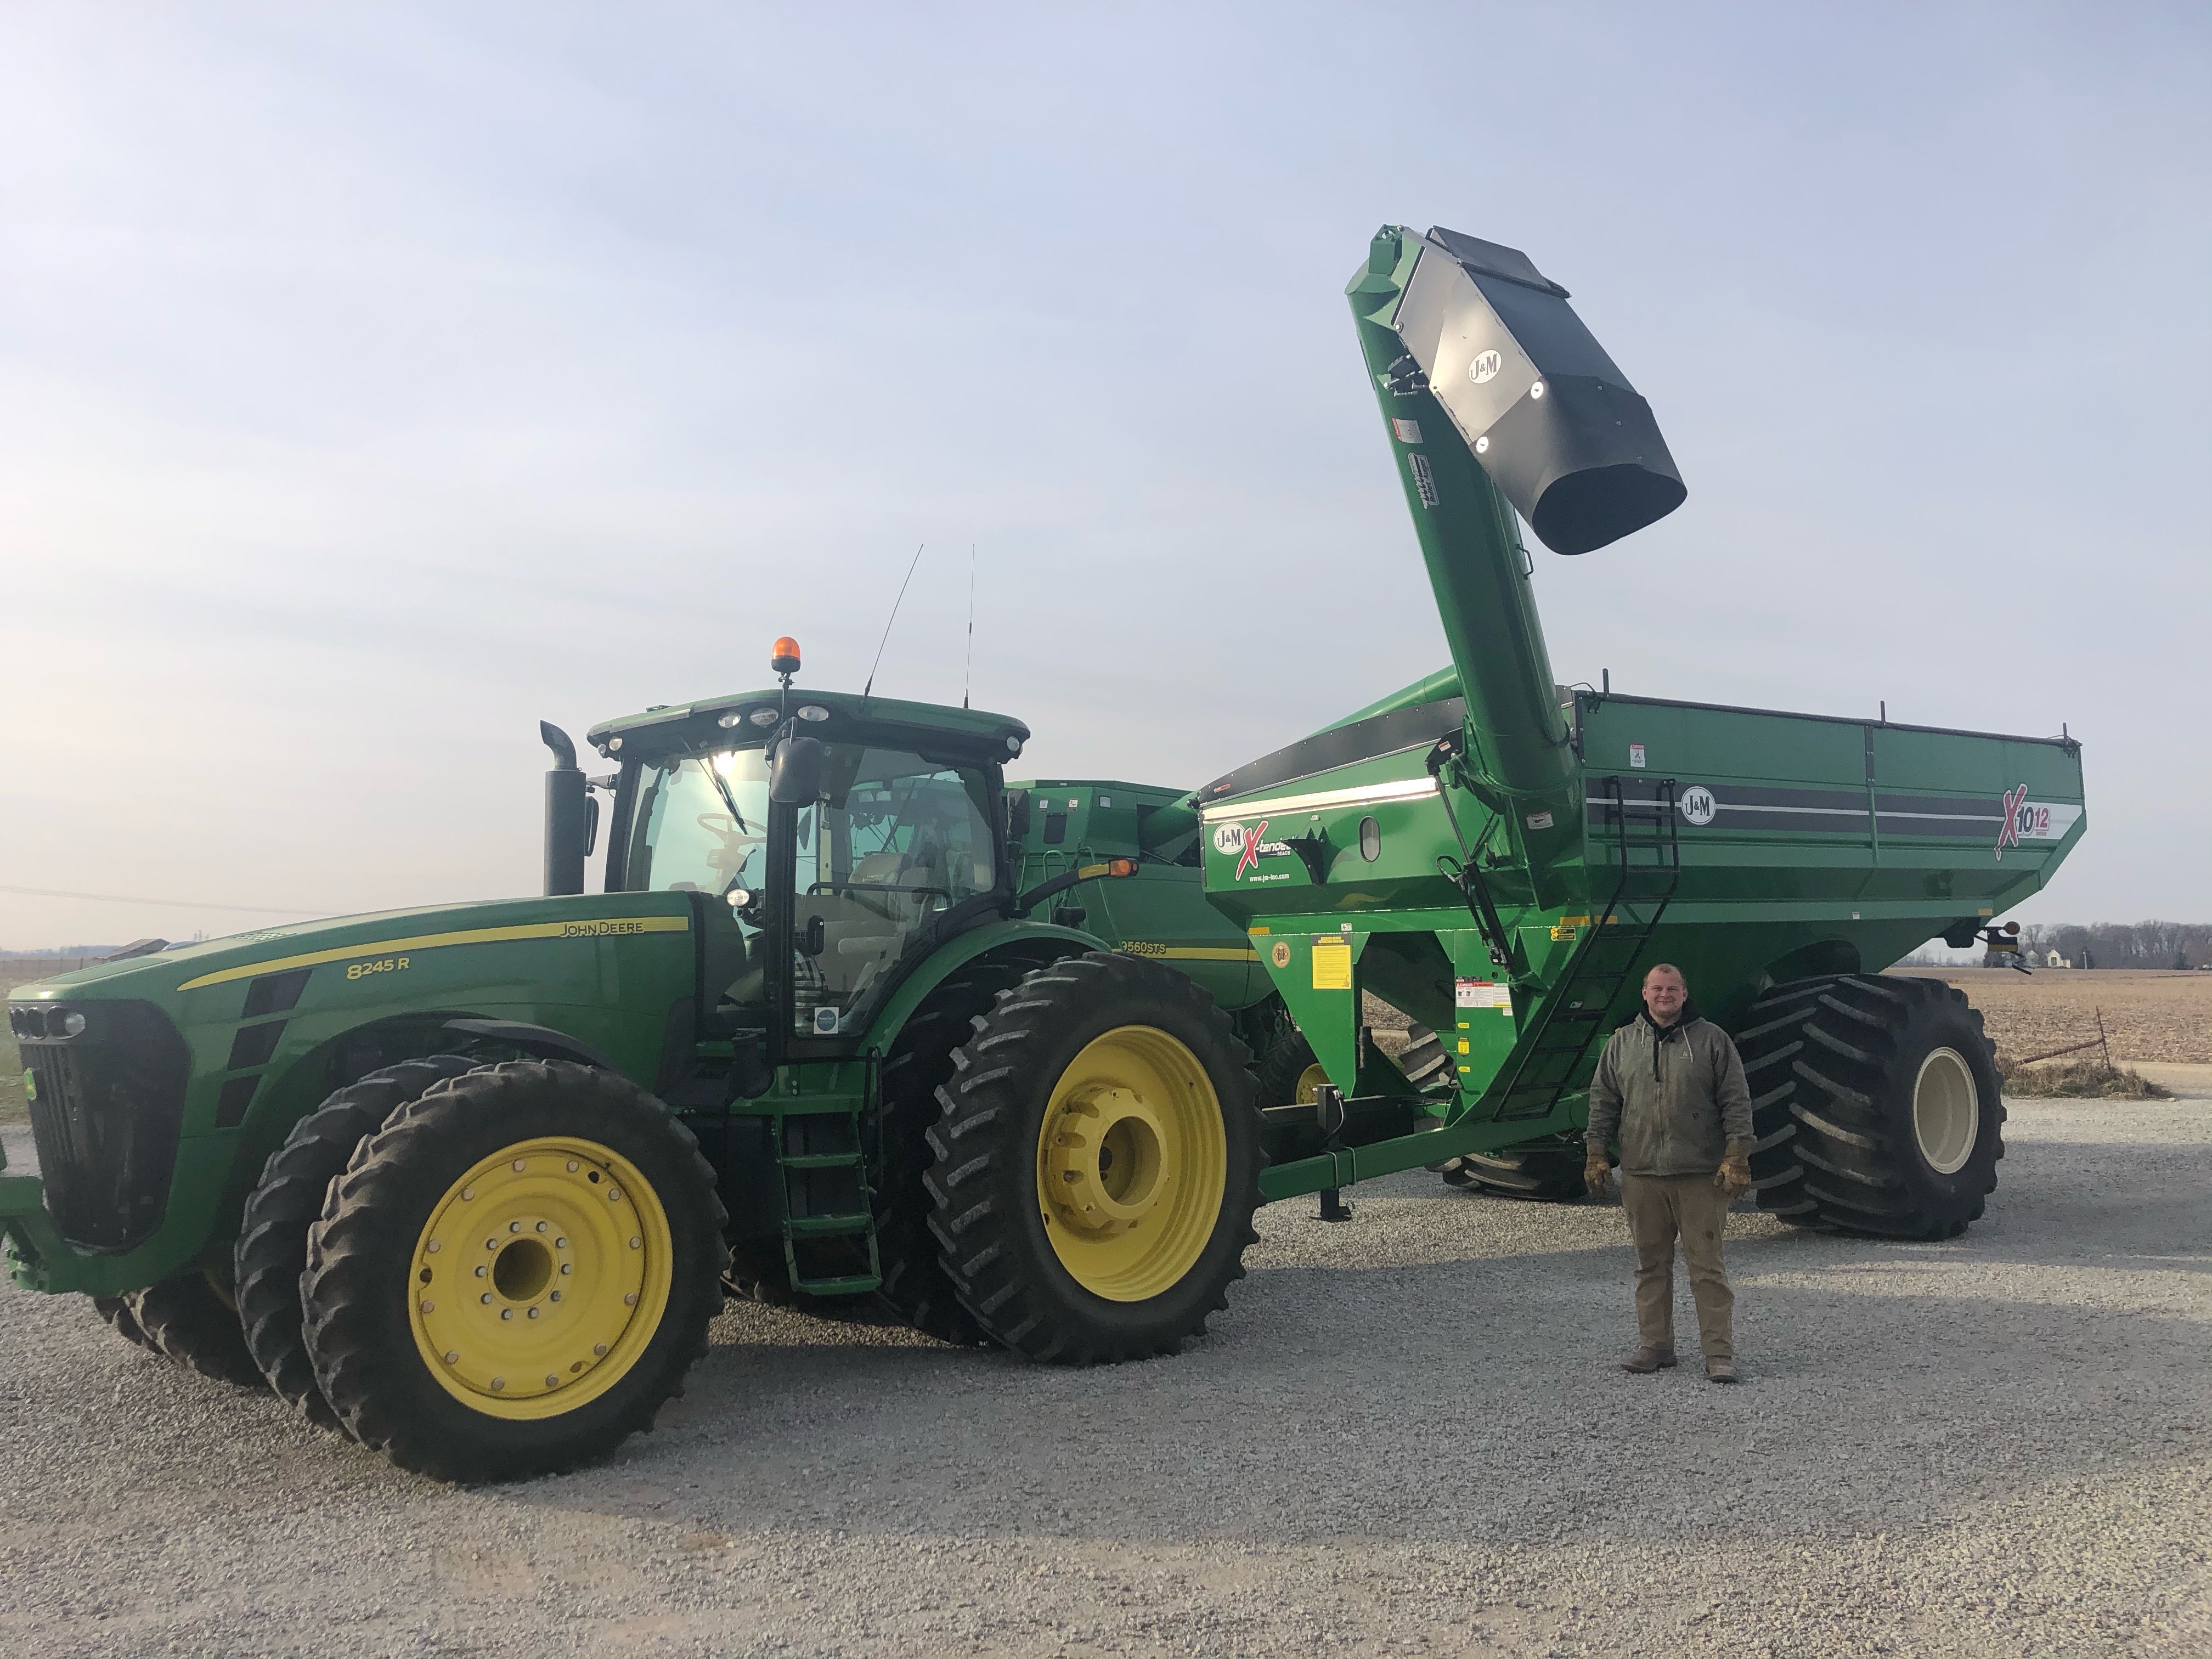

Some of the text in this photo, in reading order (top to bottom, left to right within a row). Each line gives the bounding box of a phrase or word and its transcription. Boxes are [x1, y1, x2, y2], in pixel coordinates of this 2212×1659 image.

[1470, 353, 1498, 380] J&M
[1685, 795, 1711, 816] J&M
[1217, 828, 1242, 848] J&M
[1249, 873, 1289, 883] www.jm-inc.com
[560, 922, 644, 936] JOHN DEERE
[347, 957, 410, 980] 8245 R
